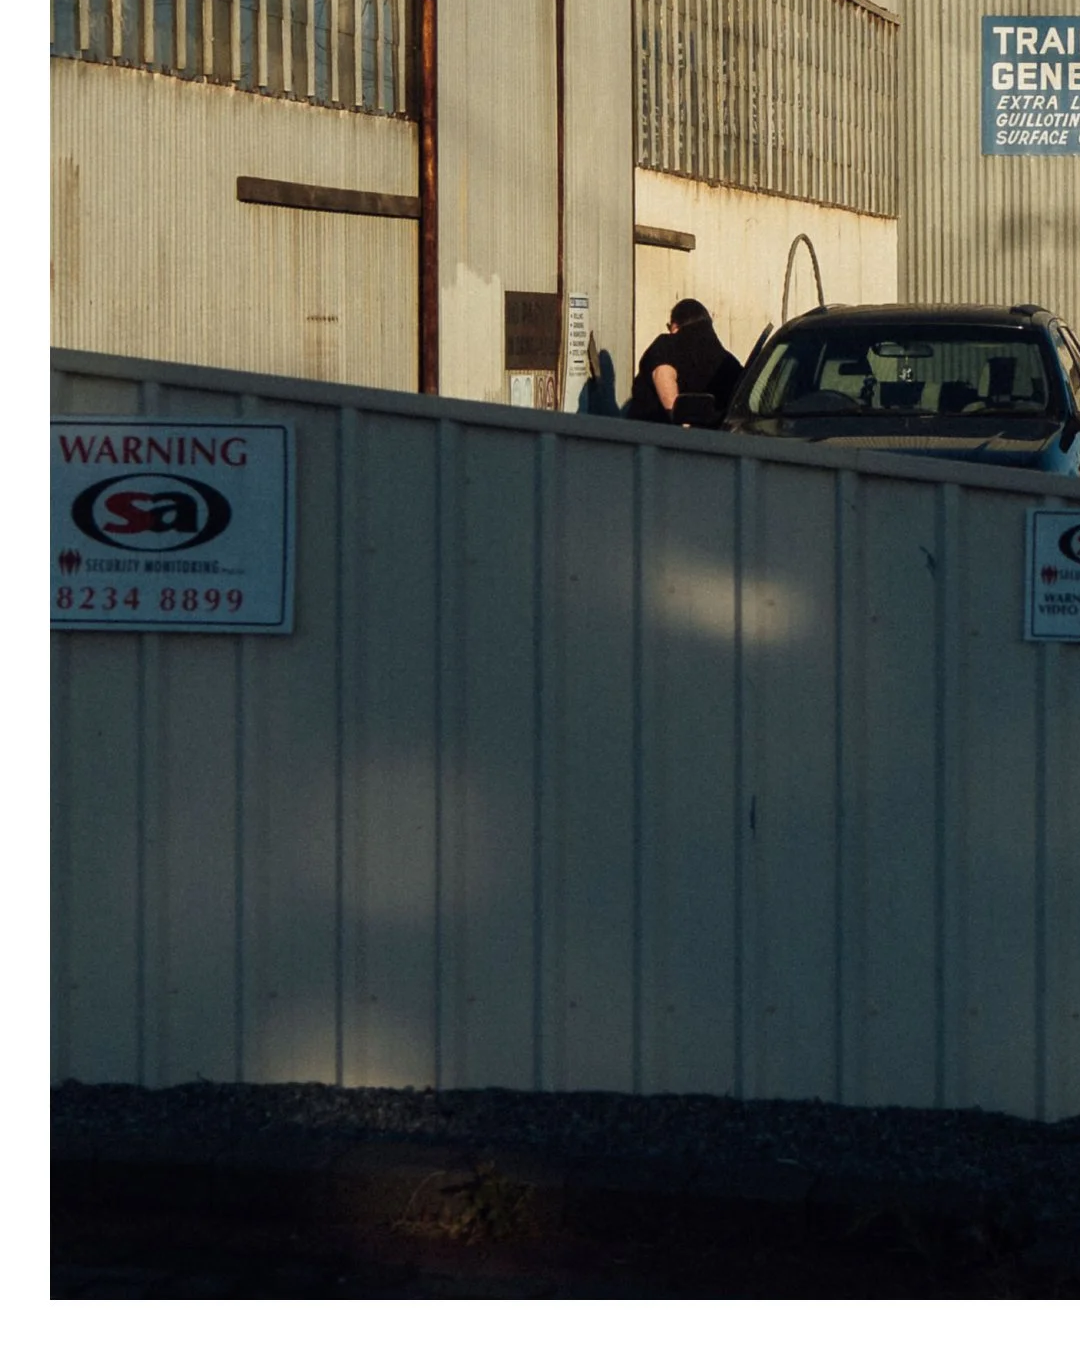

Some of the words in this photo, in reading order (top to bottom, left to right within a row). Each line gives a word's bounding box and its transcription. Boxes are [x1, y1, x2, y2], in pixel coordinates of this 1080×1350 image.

[996, 95, 1060, 111] EXTRA
[995, 129, 1069, 146] SURFACE
[59, 435, 248, 467] WARNING
[103, 491, 199, 534] sa
[85, 558, 141, 574] SECURITY
[144, 559, 220, 575] MONITORING
[56, 586, 141, 610] 8234
[159, 587, 244, 612] 8899
[1039, 604, 1078, 615] VIDEO
